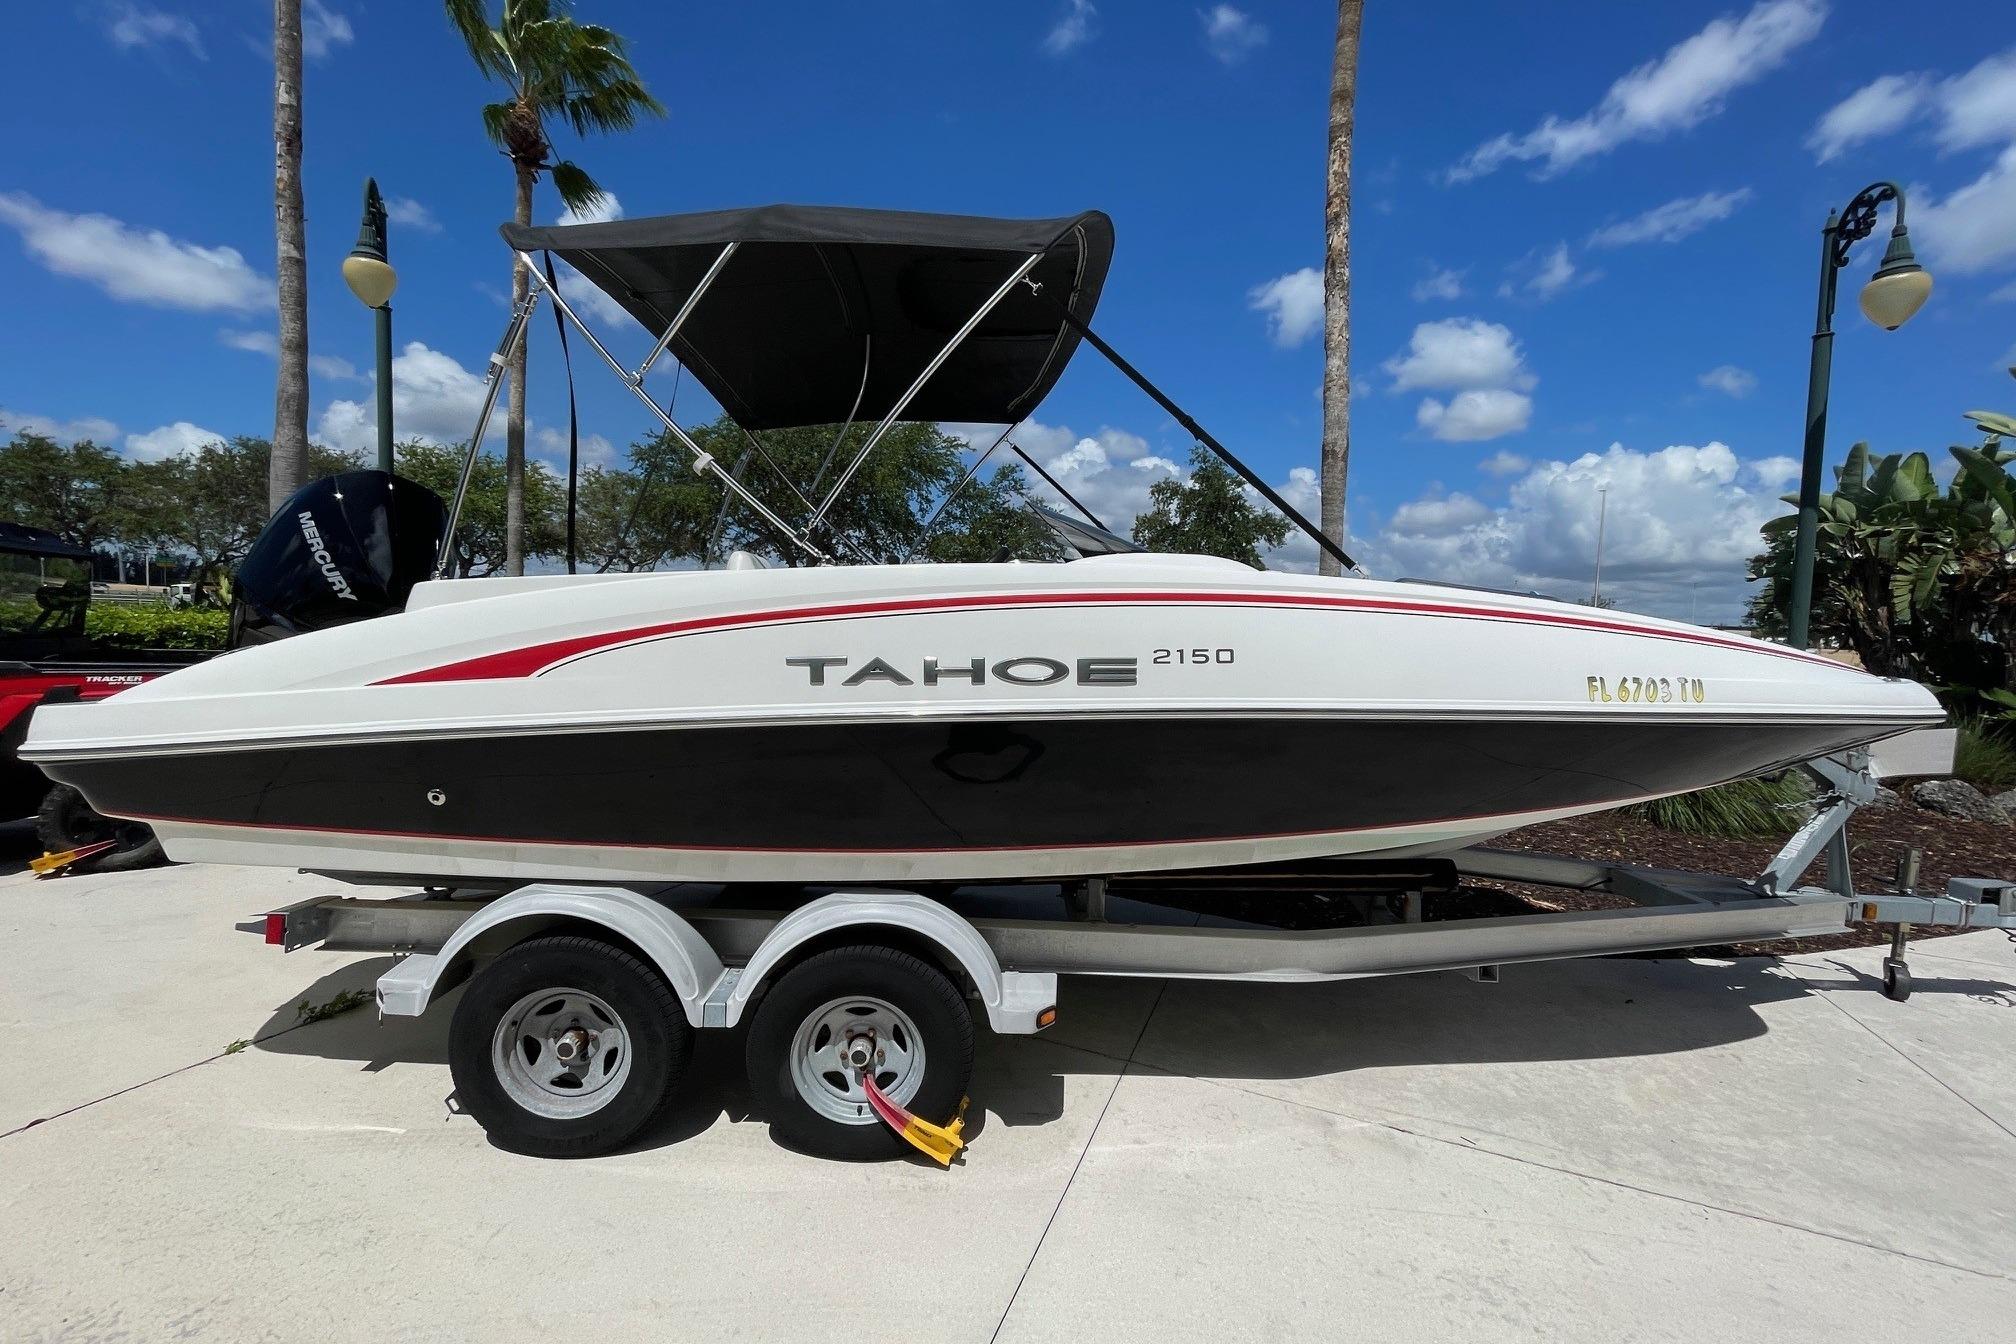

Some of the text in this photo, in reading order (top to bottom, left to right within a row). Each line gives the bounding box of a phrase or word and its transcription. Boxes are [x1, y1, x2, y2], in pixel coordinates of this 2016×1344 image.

[298, 511, 358, 600] MERCURY
[85, 675, 143, 683] TRACKER
[785, 648, 1236, 687] TAHOE 2150
[1586, 676, 1704, 703] FL 6703 TU
